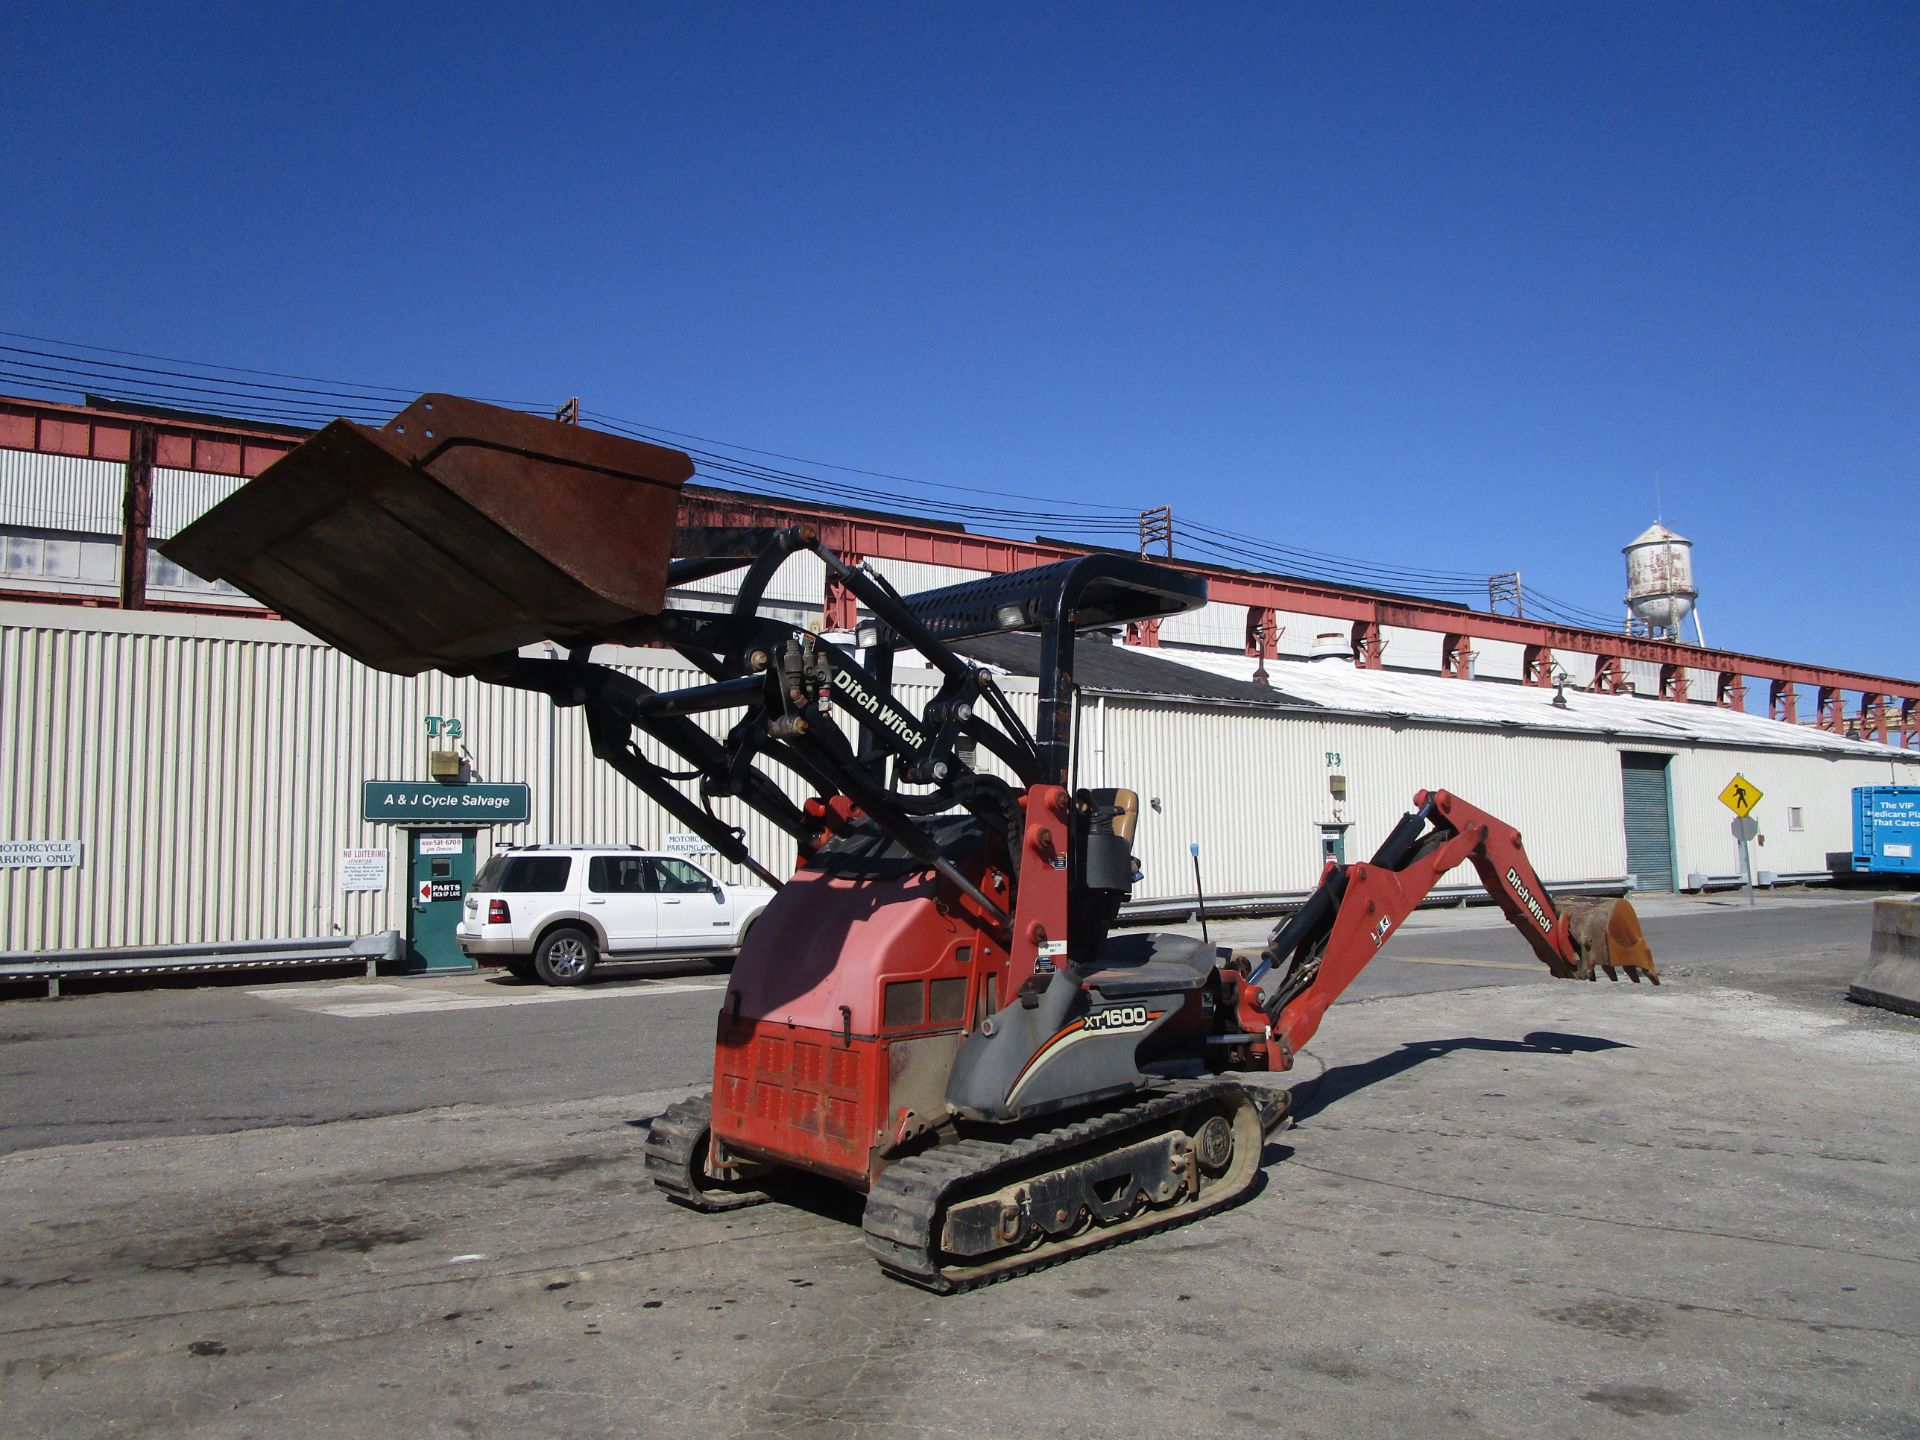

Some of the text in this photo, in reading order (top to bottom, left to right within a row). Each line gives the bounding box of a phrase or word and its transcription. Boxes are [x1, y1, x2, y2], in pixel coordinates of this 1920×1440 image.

[833, 669, 924, 750] Ditch Witch
[424, 715, 463, 737] T2
[1325, 752, 1341, 767] T3
[383, 794, 510, 809] A & J Cycle Salvage
[0, 854, 76, 863] ARKING ONLY
[343, 850, 386, 858] NO LOITERING
[432, 884, 461, 892] PARTS
[1506, 868, 1551, 933] Ditch Witch
[1084, 1007, 1146, 1028] XT1600
